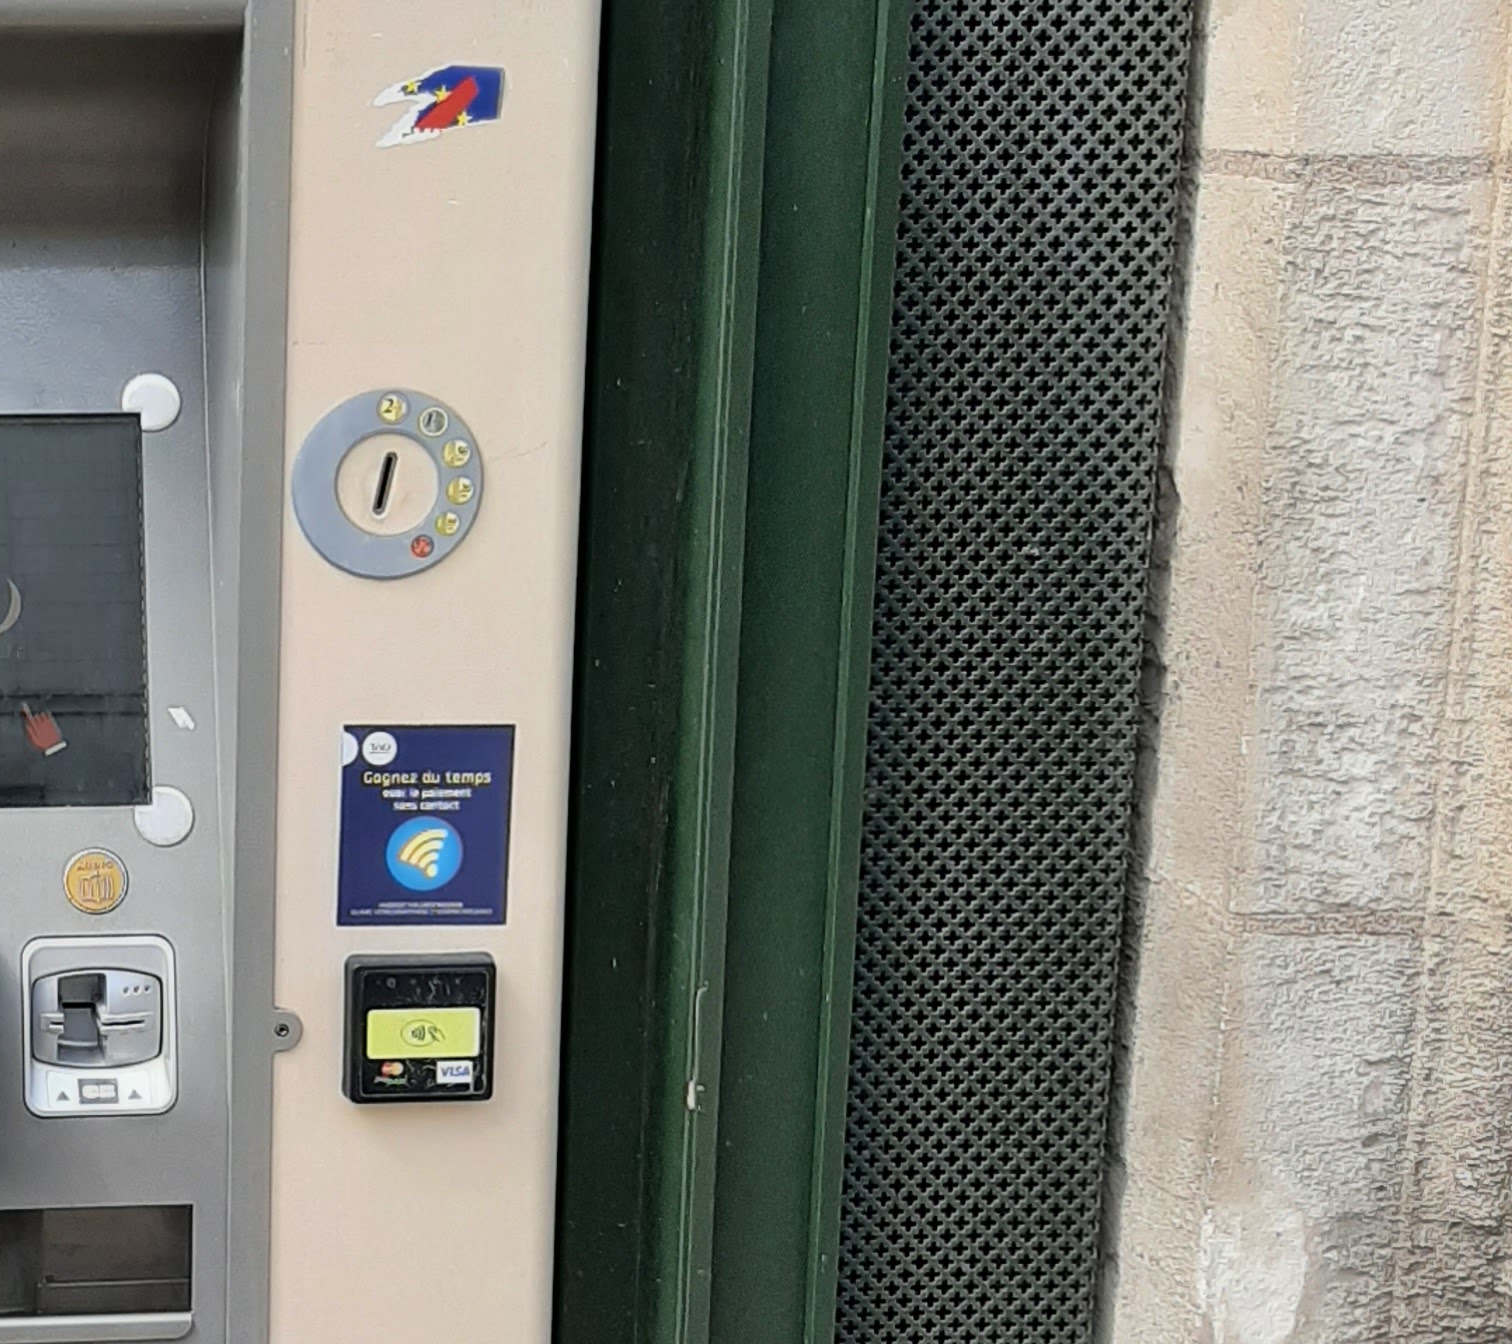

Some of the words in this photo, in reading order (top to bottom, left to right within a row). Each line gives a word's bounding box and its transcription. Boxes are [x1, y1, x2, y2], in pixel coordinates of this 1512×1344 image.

[363, 770, 418, 787] Gagnez
[422, 770, 440, 784] du
[445, 770, 492, 786] temps
[440, 1065, 471, 1077] VISA
